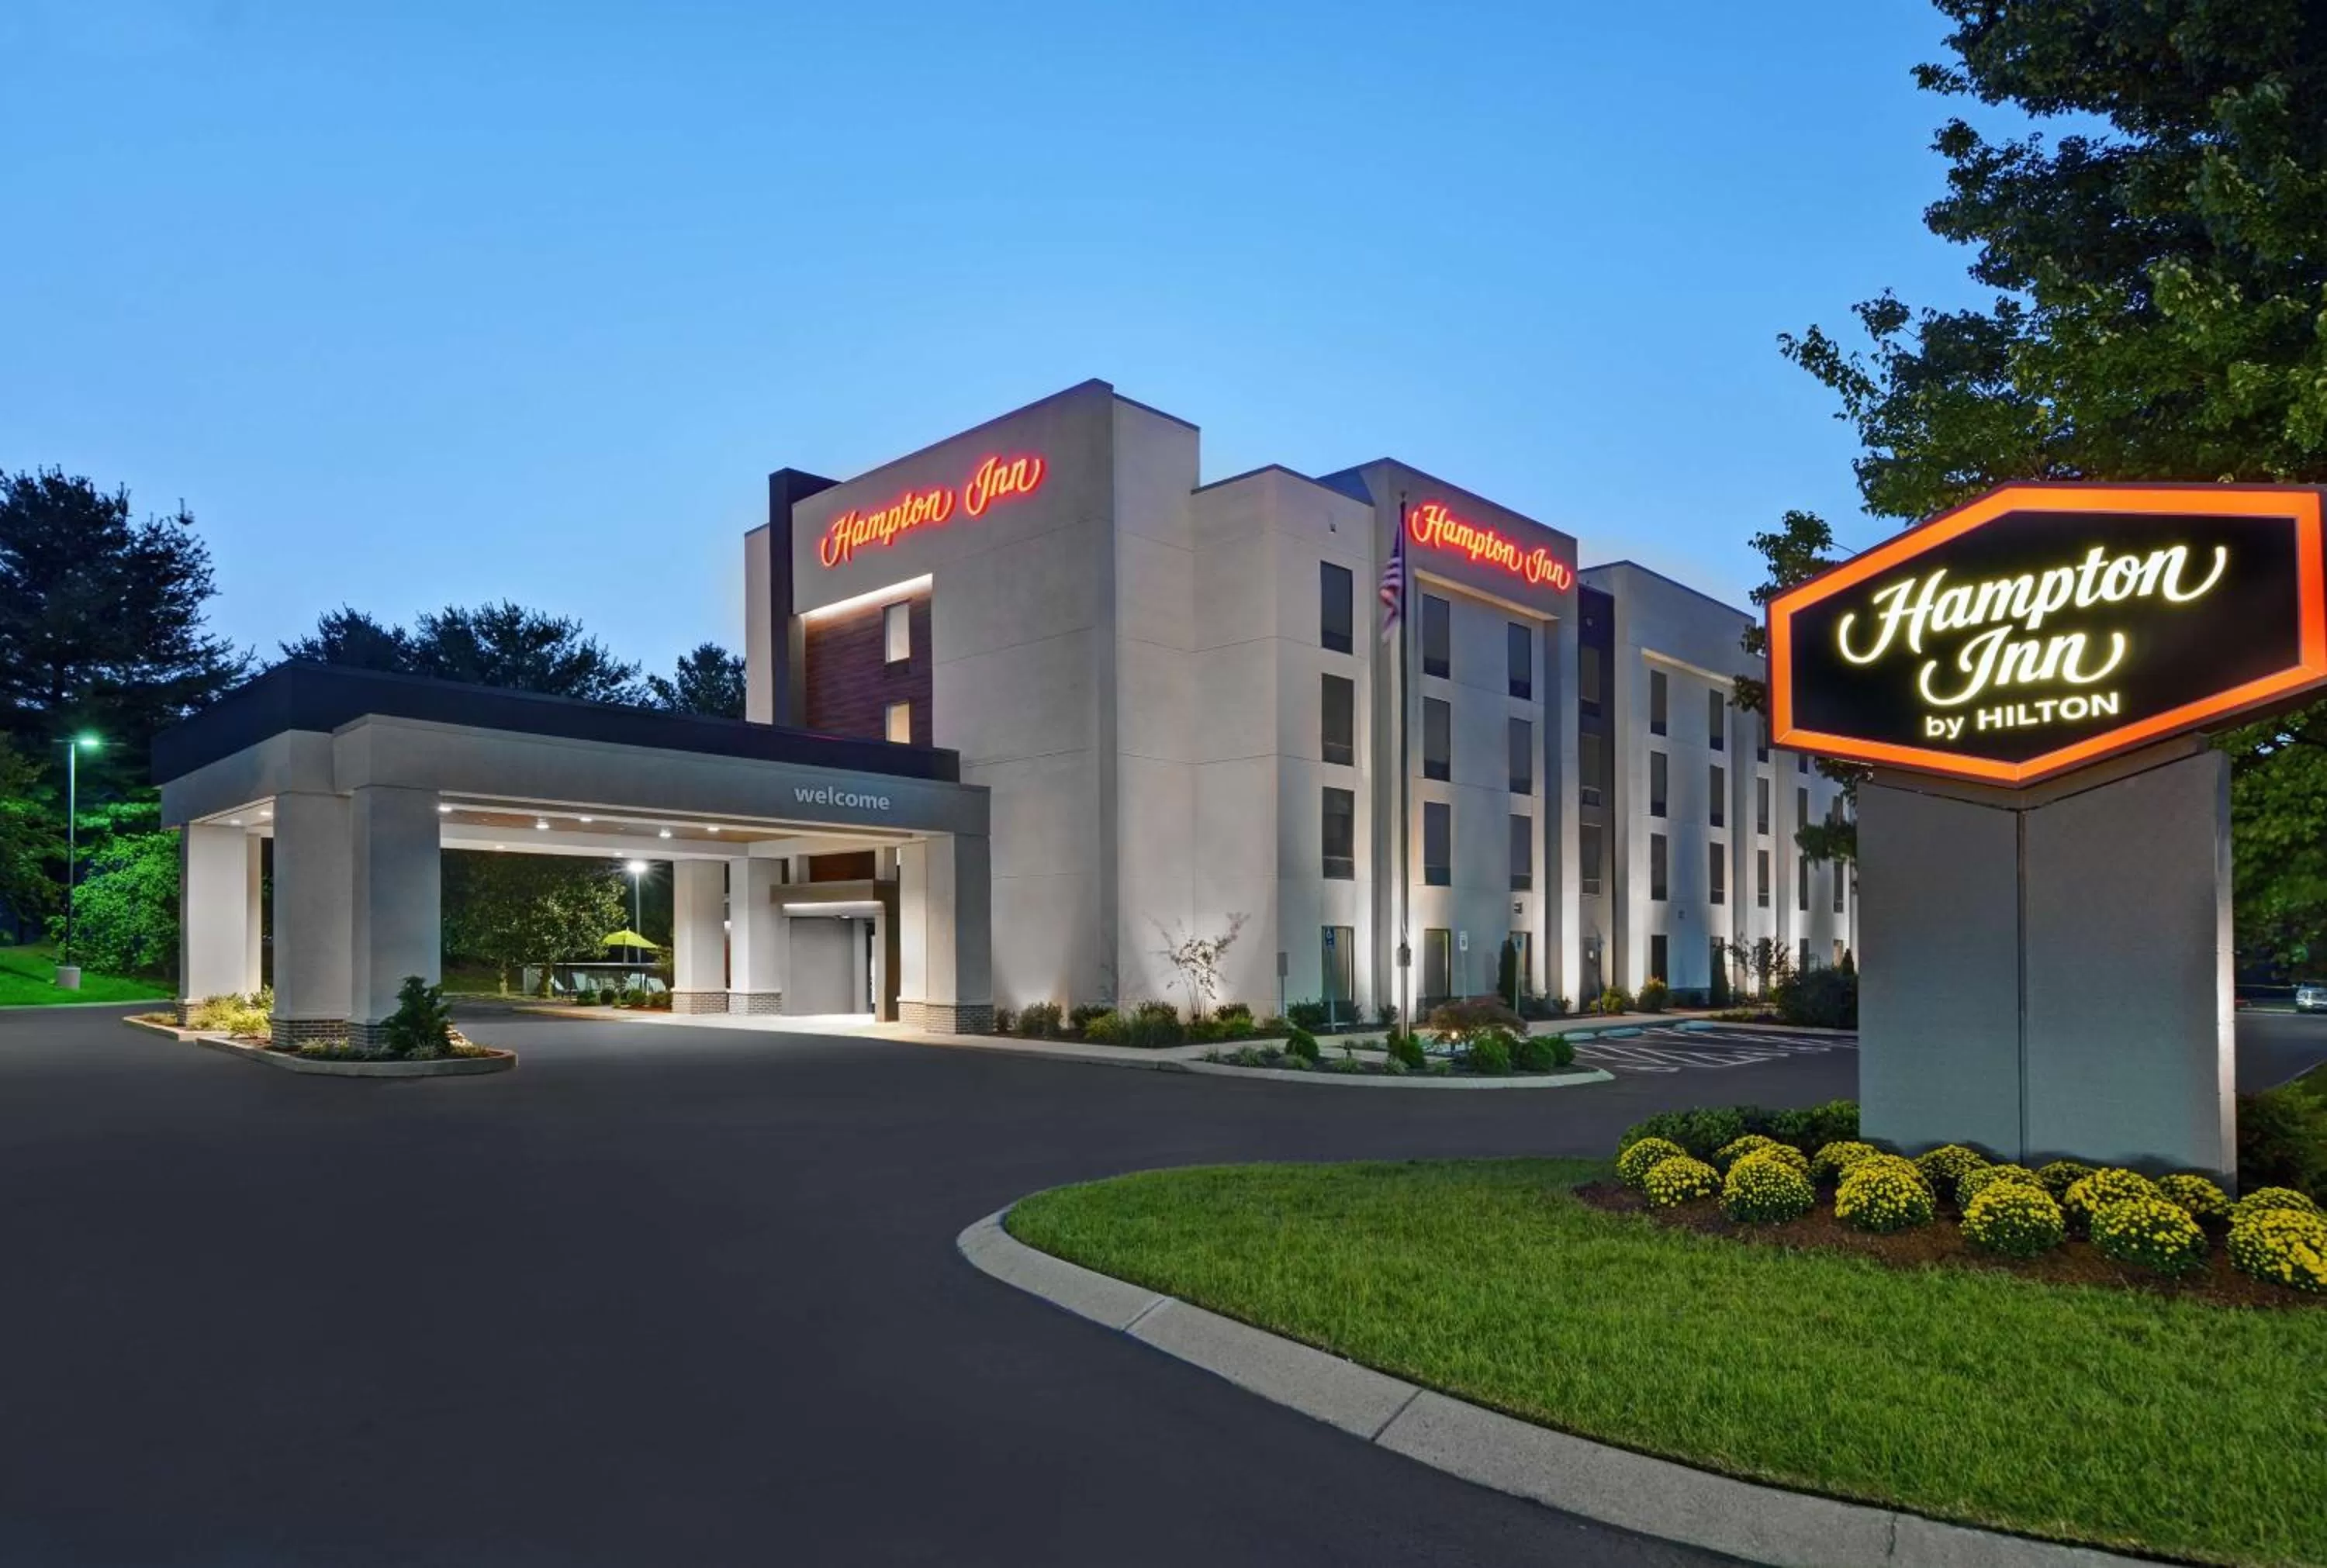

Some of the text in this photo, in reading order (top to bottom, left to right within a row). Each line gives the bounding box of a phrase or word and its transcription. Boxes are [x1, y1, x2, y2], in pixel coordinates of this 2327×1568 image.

[821, 456, 1044, 568] Hampton Inn
[1411, 504, 1572, 591] Hampton Inn
[1838, 544, 2227, 664] Hampton
[1919, 623, 2125, 706] Inn
[1925, 692, 2119, 740] by HILTON
[794, 786, 890, 810] welcome
